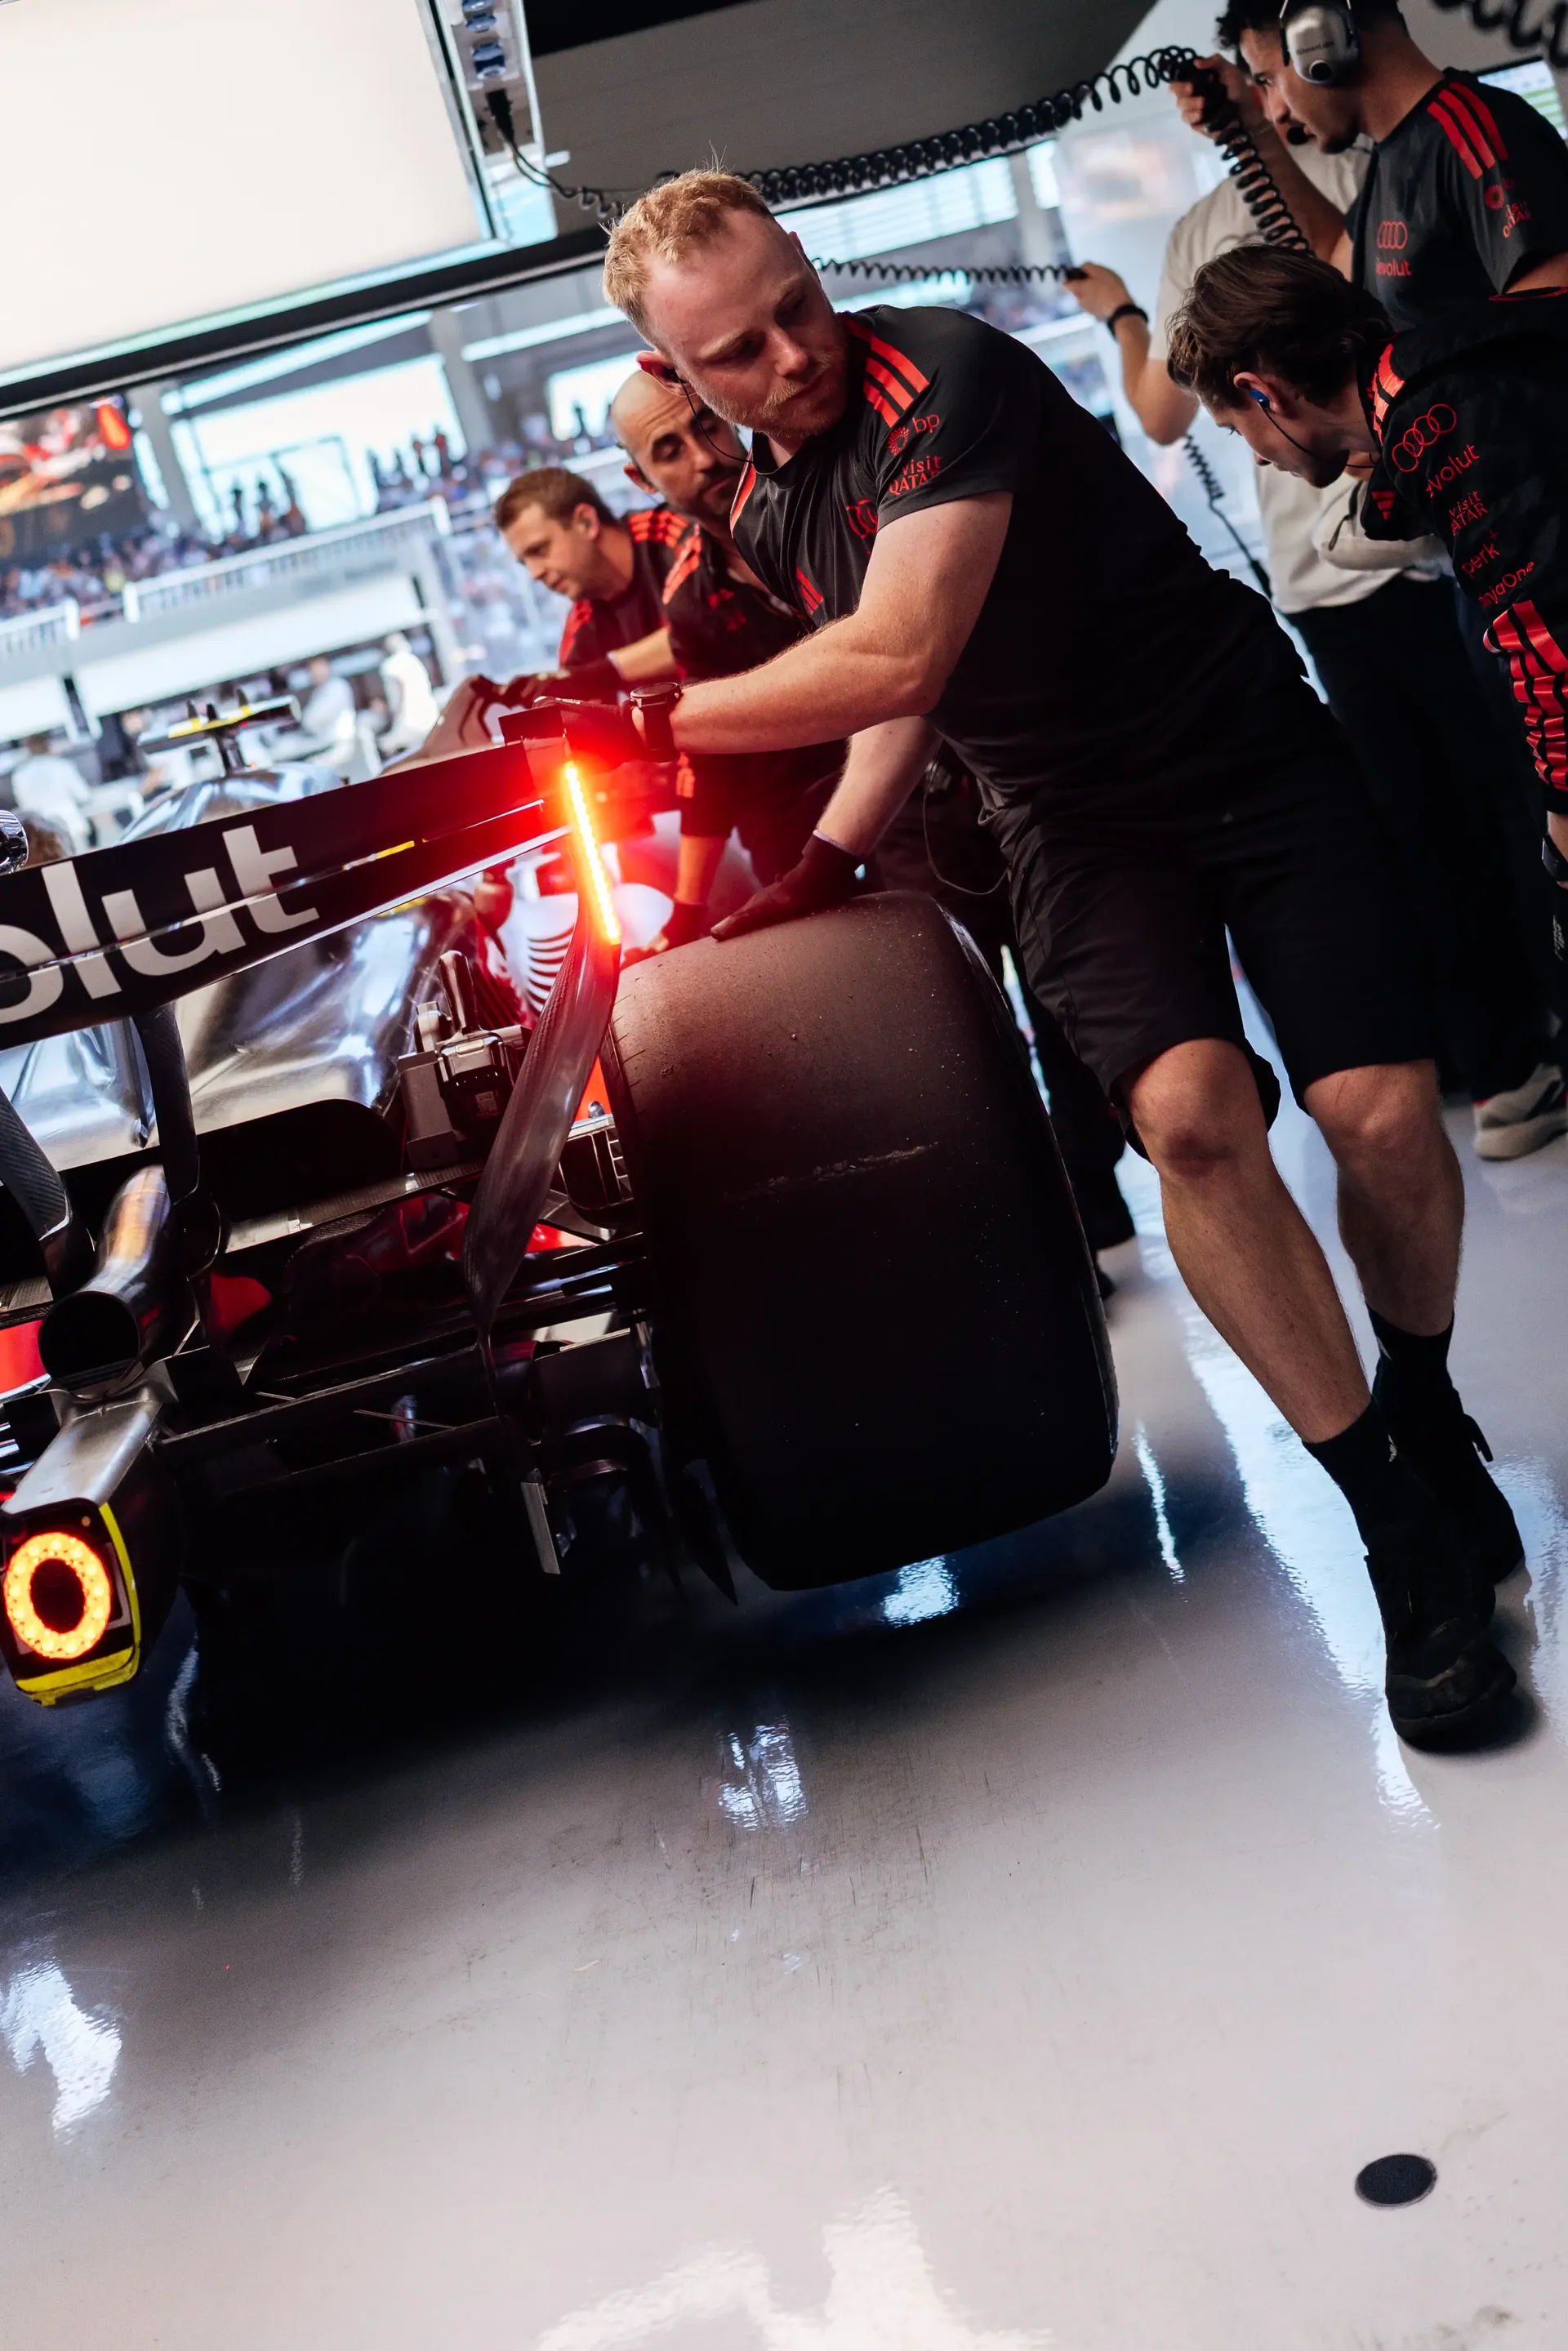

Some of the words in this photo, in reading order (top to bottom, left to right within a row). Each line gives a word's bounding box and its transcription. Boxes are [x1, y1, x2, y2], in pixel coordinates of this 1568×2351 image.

[912, 414, 940, 434] bp
[902, 456, 941, 476] visit
[1426, 444, 1480, 498] volut
[1449, 491, 1481, 517] visit
[1450, 502, 1489, 537] ATAR
[1461, 543, 1500, 579] perk
